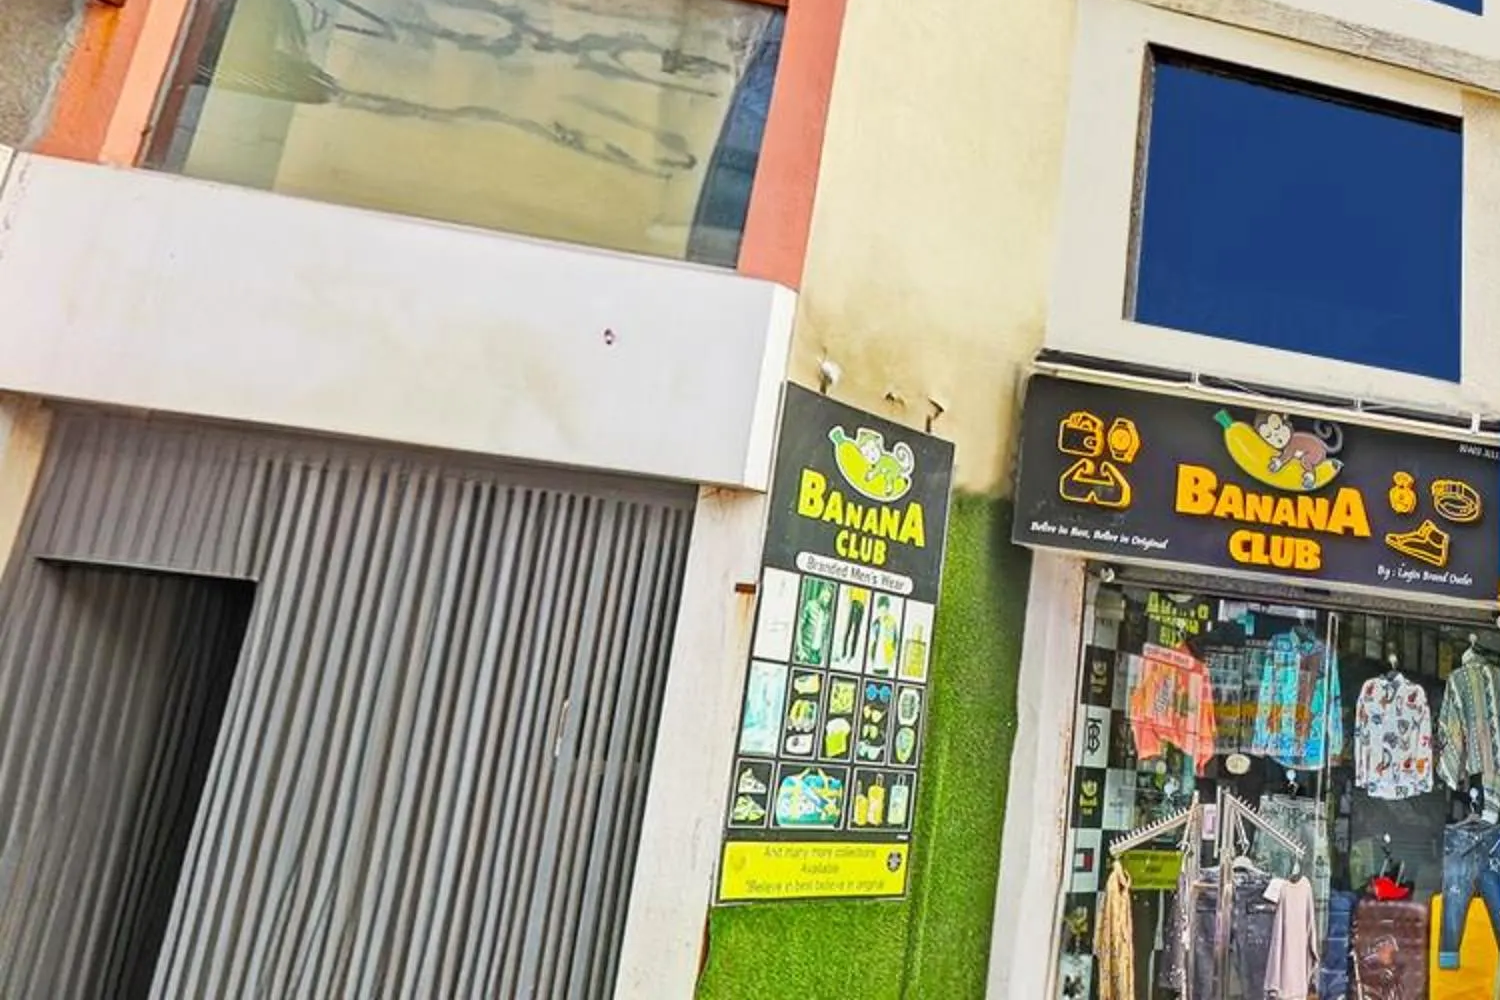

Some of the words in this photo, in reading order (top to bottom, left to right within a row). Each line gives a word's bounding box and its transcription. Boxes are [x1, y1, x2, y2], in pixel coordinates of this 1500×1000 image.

[798, 467, 925, 548] BANANA
[1175, 463, 1371, 538] BANANA
[835, 529, 887, 566] CLUB
[1131, 535, 1169, 550] Original
[1229, 530, 1322, 571] CLUB
[1377, 564, 1391, 581] By
